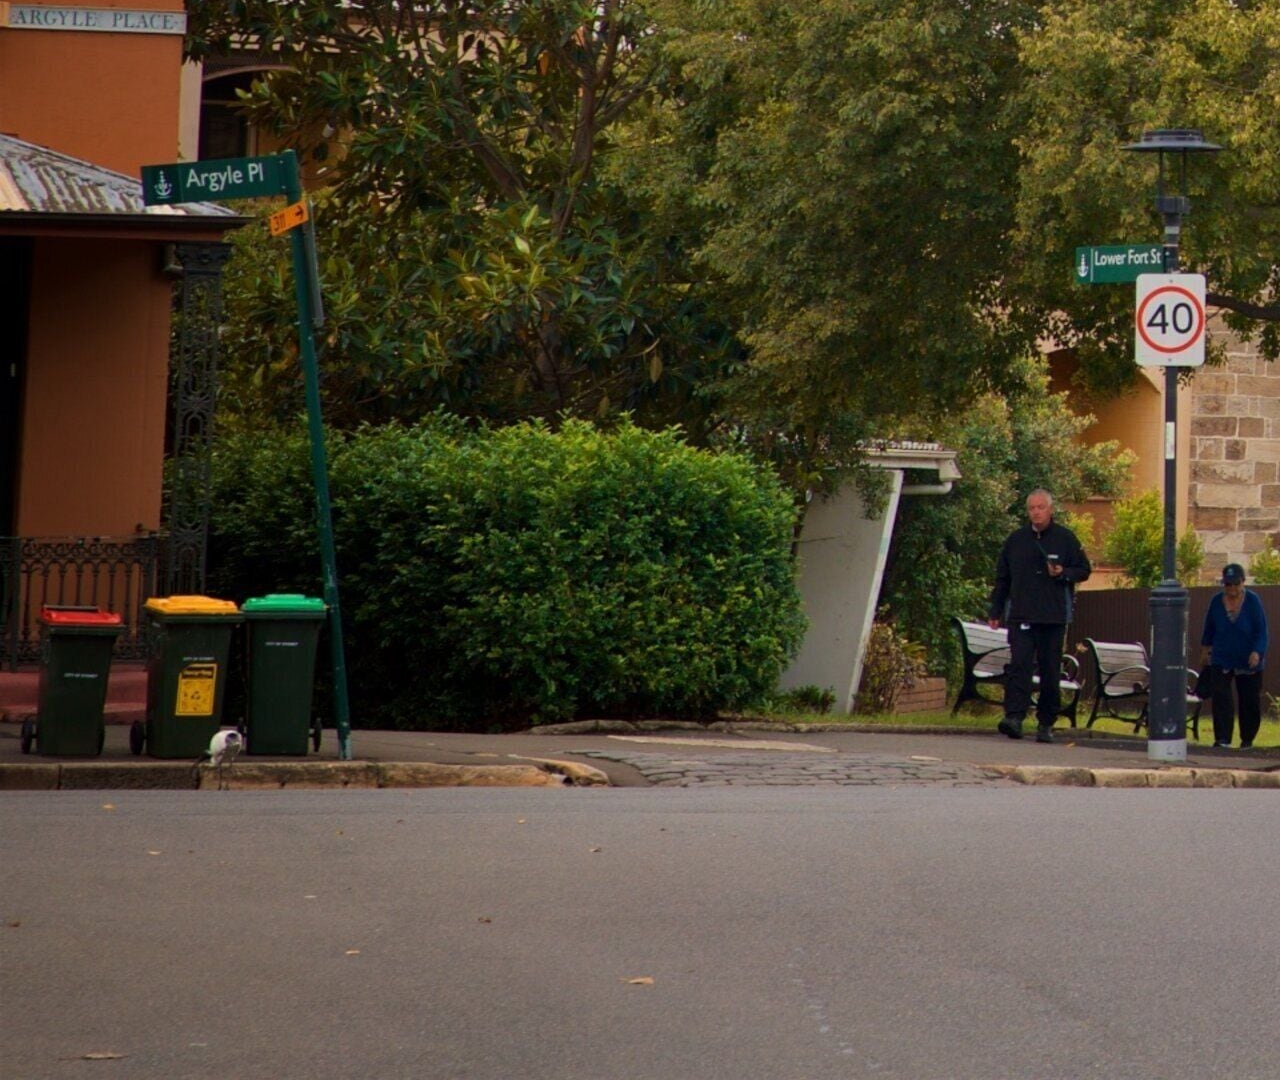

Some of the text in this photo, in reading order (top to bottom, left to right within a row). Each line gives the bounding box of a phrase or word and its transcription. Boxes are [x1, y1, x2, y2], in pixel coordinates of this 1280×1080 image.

[14, 9, 175, 30] ARGYLE PLACE
[186, 162, 264, 192] Argyle Pl
[1094, 248, 1162, 266] Lower Fort St
[1146, 302, 1193, 334] 40
